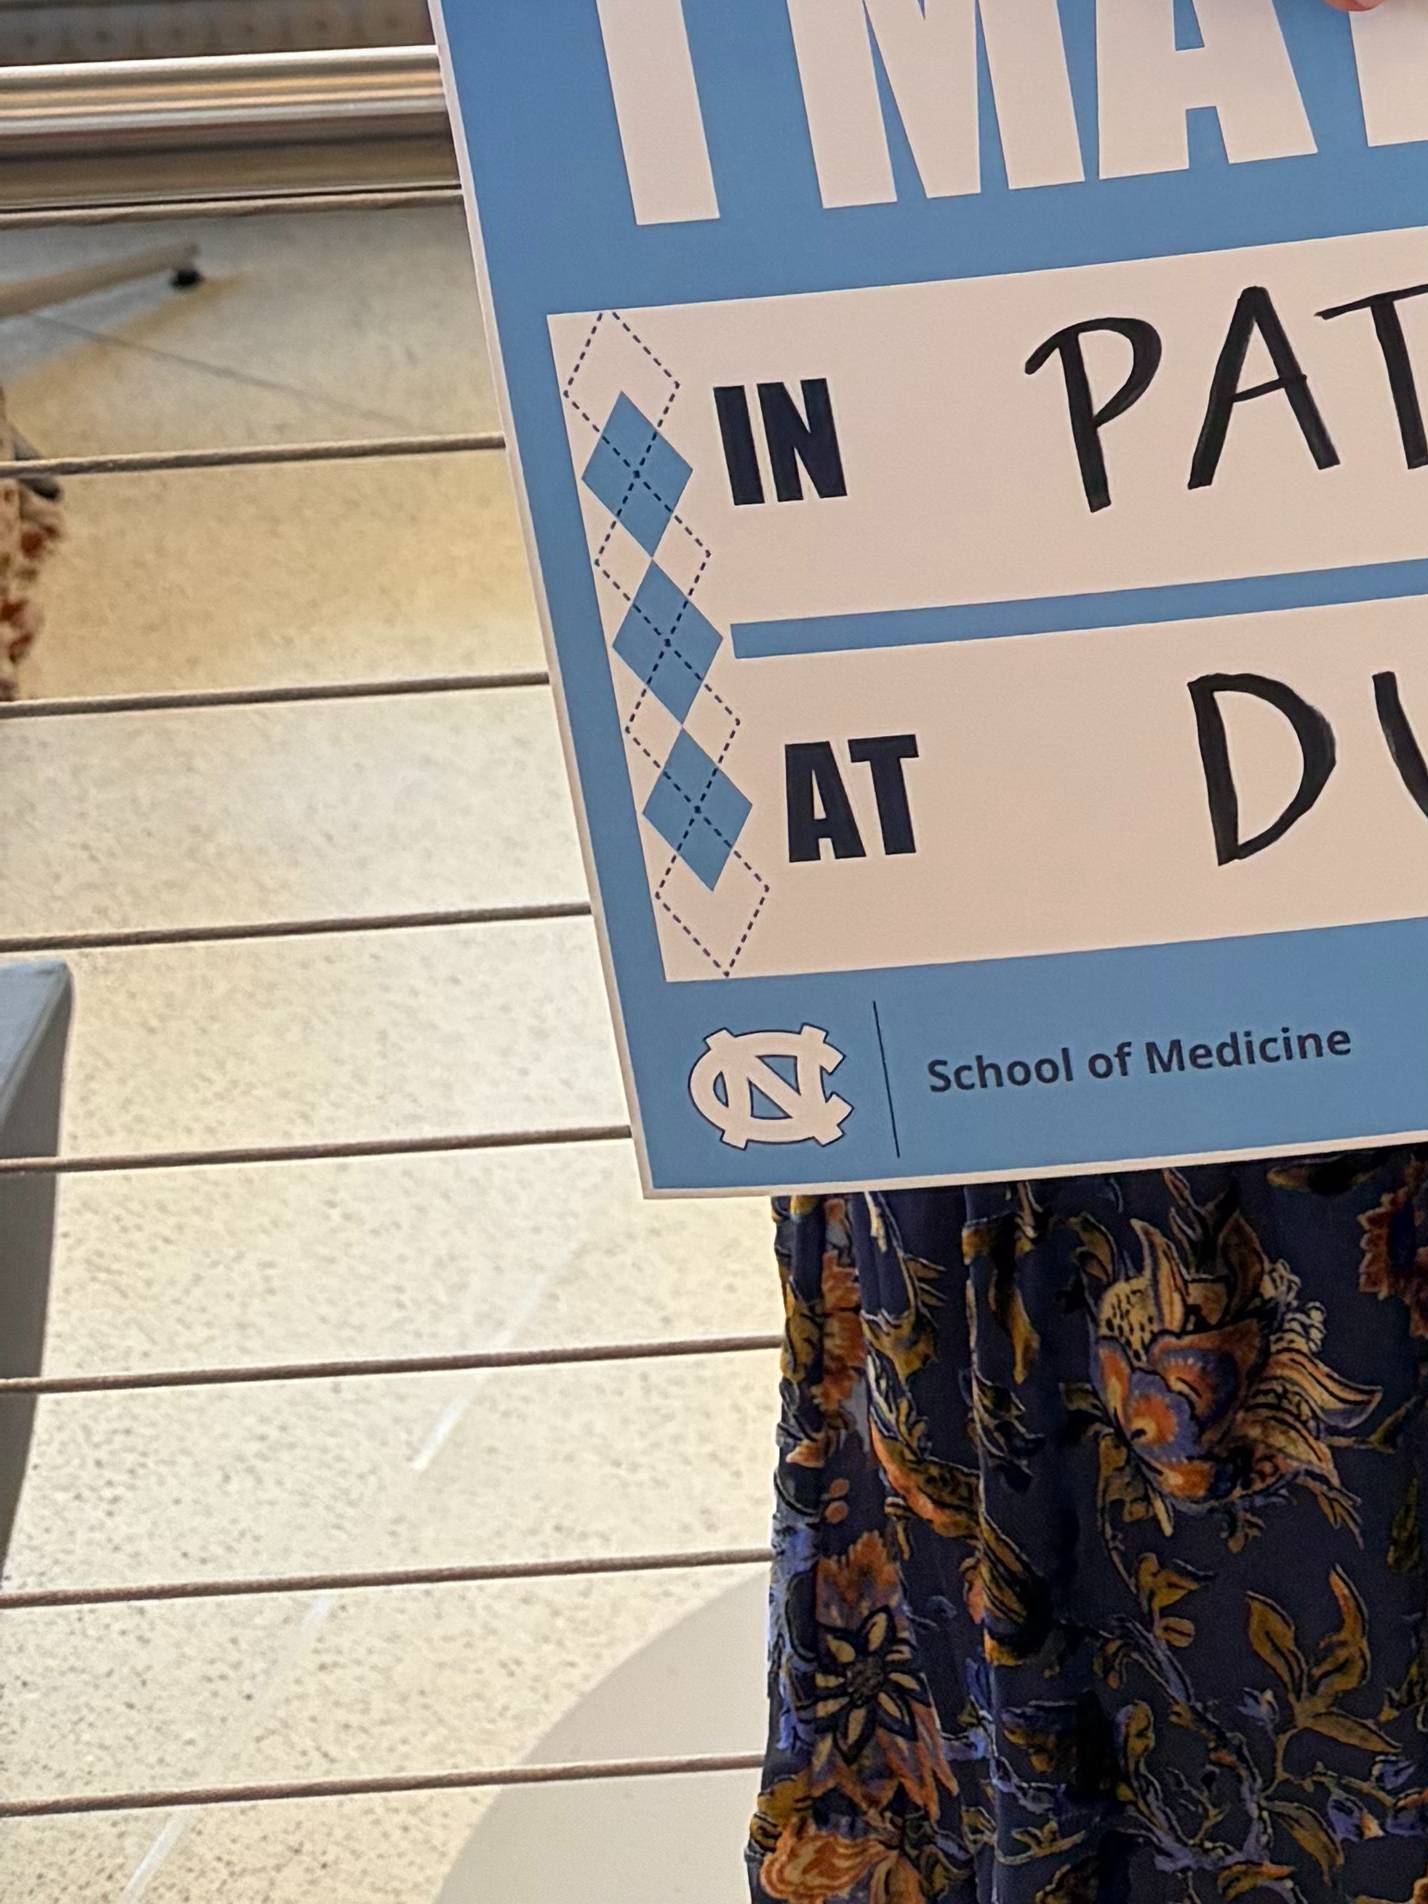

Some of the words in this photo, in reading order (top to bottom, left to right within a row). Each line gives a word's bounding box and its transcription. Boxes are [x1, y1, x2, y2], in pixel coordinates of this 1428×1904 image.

[714, 378, 847, 505] IN
[785, 735, 918, 862] AT
[927, 1048, 1074, 1093] School
[1088, 1043, 1133, 1079] of
[1145, 1026, 1352, 1075] Medicine
